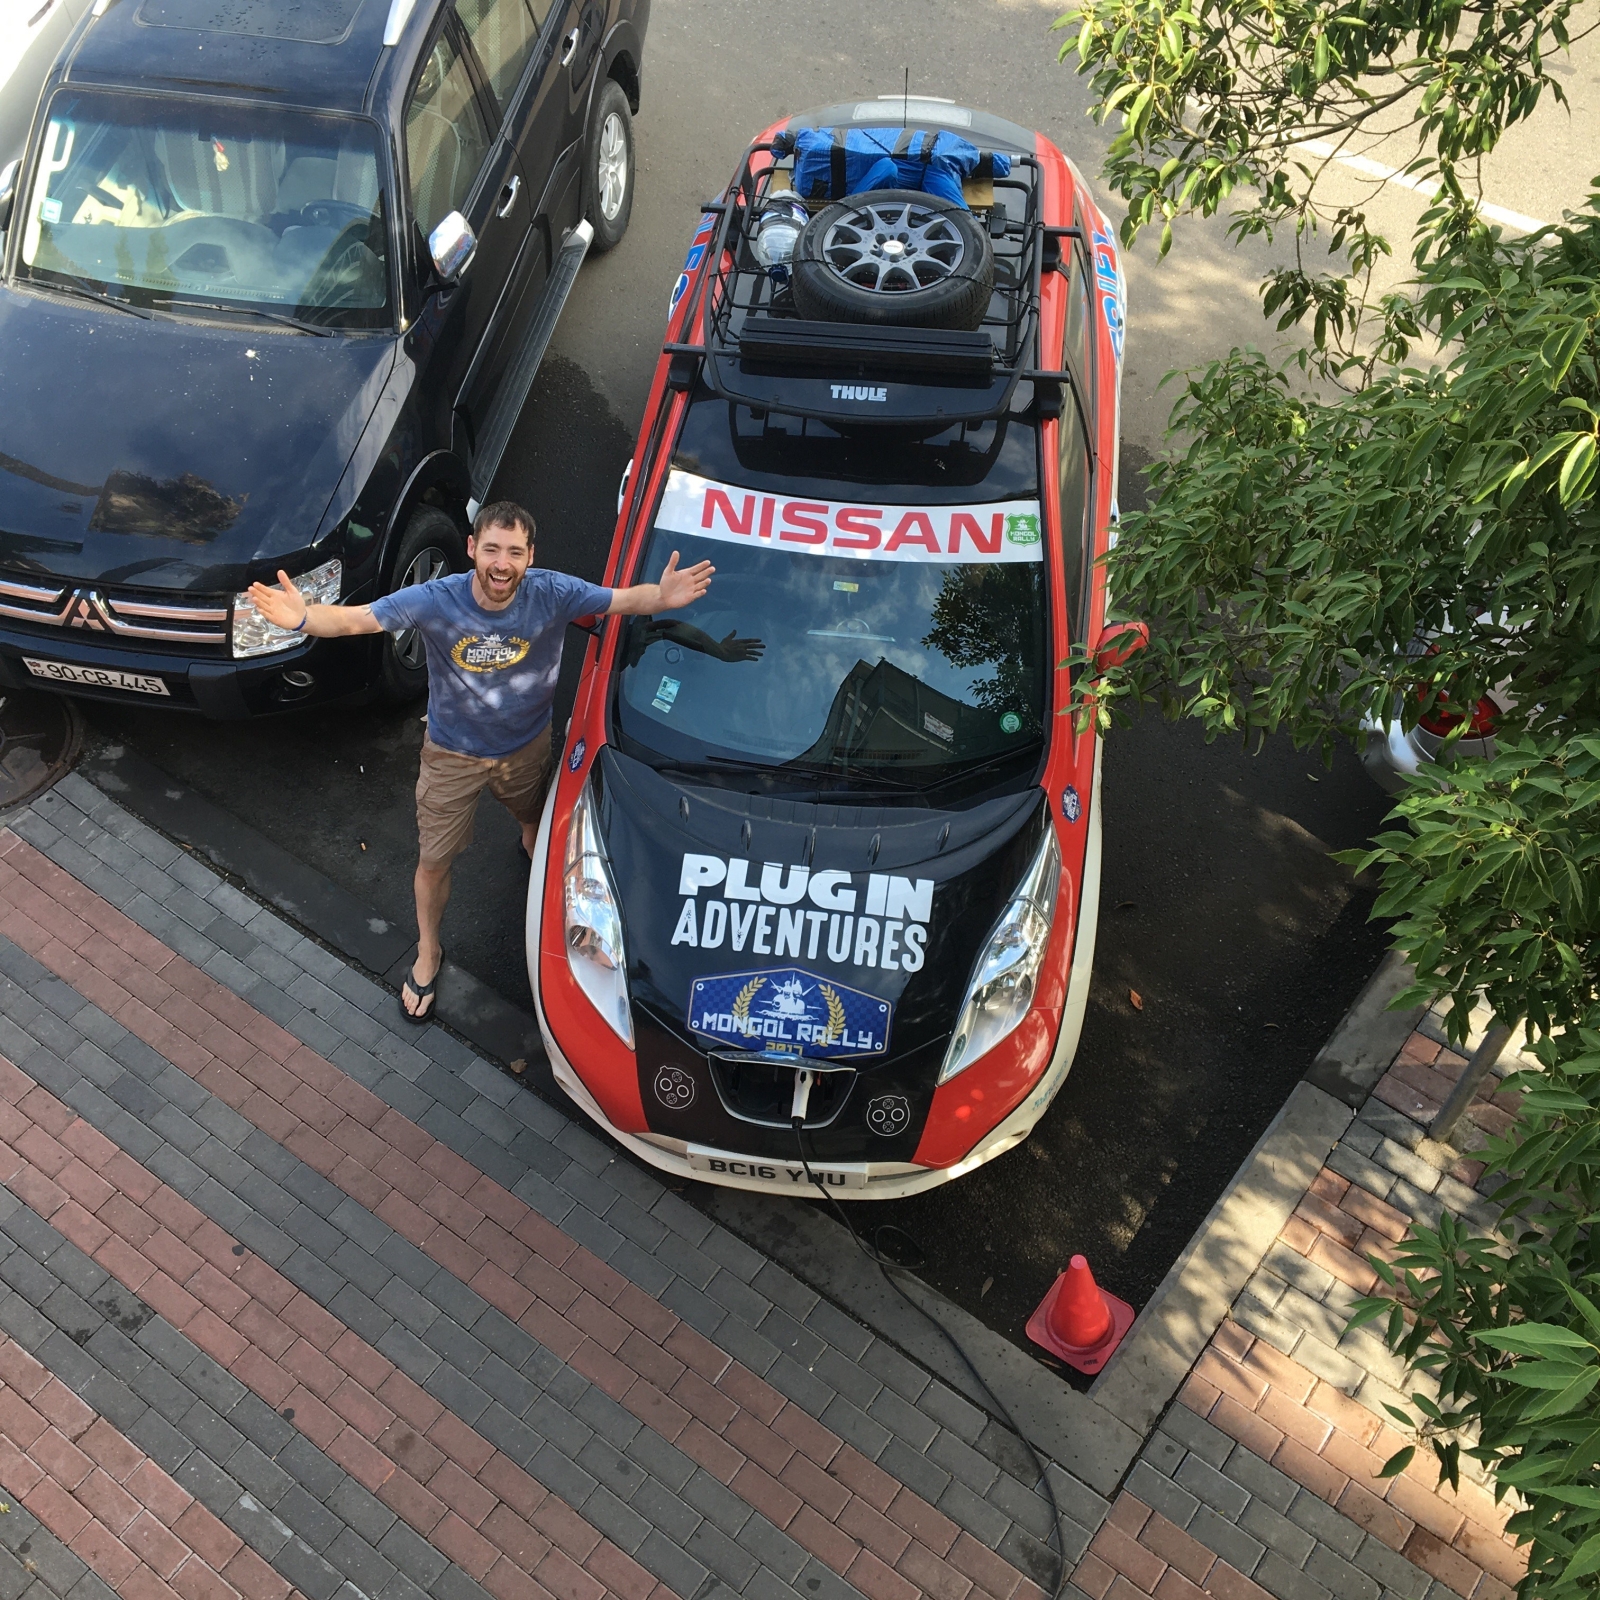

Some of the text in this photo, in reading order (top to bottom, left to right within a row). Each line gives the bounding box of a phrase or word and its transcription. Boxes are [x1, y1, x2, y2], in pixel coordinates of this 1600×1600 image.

[830, 384, 888, 402] THULE
[701, 488, 1004, 554] NISSAN
[33, 668, 46, 676] AZ
[46, 663, 162, 693] 90-CB-445
[678, 853, 935, 923] PLUG IN
[670, 898, 928, 973] ADVENTURES
[702, 1011, 873, 1050] MONGOL RALLY
[765, 1041, 804, 1056] 2017
[708, 1158, 776, 1180] BC16
